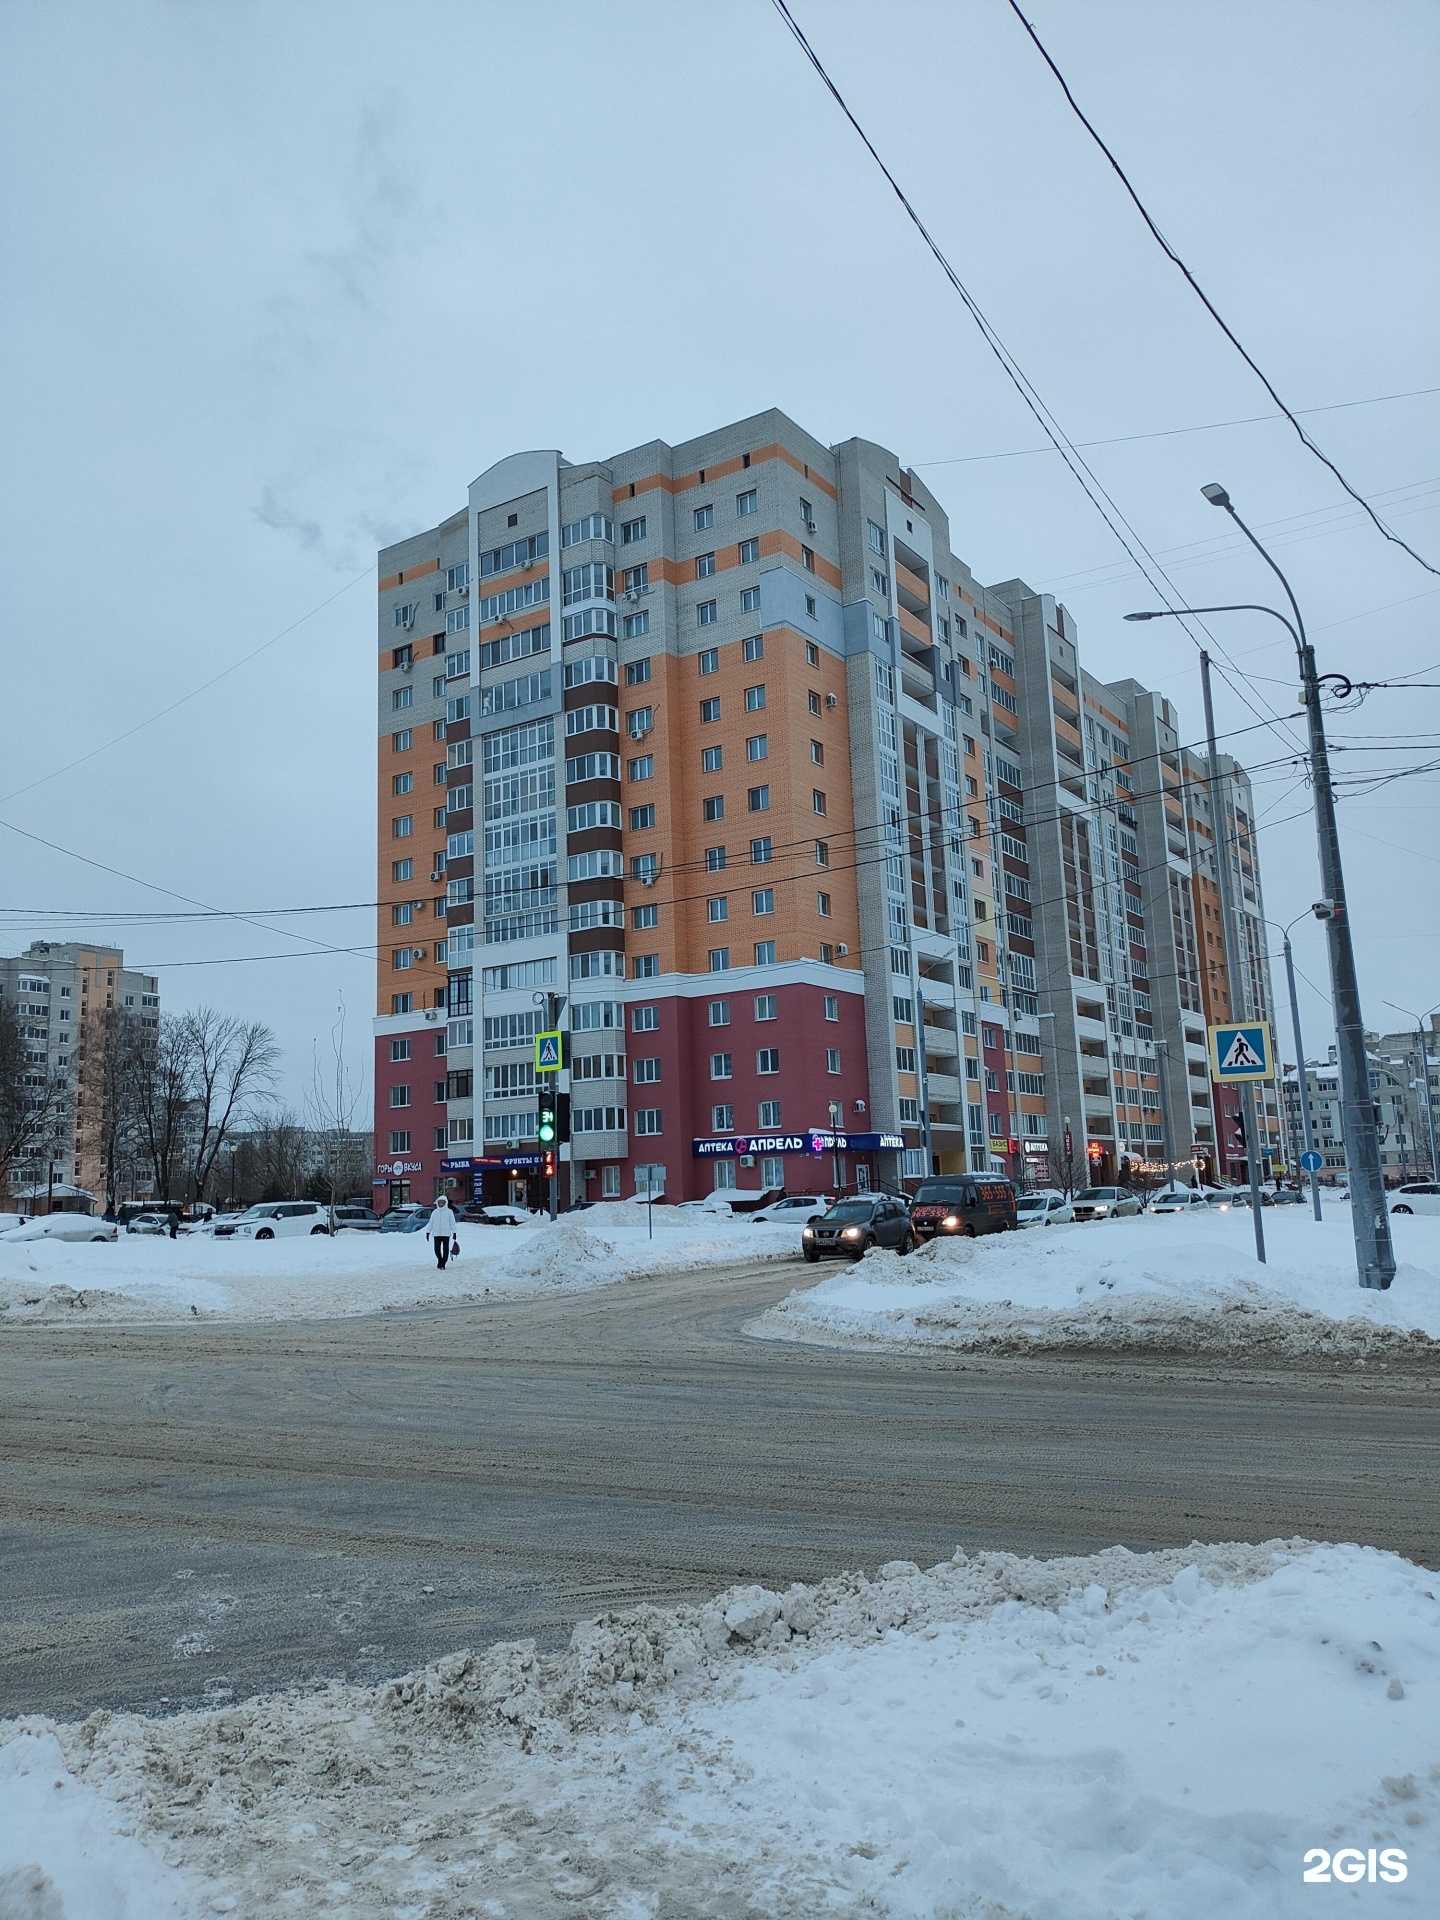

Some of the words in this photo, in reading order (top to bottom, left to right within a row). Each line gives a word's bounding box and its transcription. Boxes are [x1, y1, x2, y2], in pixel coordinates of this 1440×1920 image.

[698, 1142, 734, 1153] АПТЕКА
[749, 1137, 803, 1152] АПРЕЛЬ
[880, 1135, 904, 1148] АПТЕКА
[450, 1160, 471, 1169] РЫБА
[503, 1156, 533, 1165] ФРУКТЫ
[377, 1163, 393, 1175] ГОРЫ
[403, 1161, 422, 1172] ВКУСА
